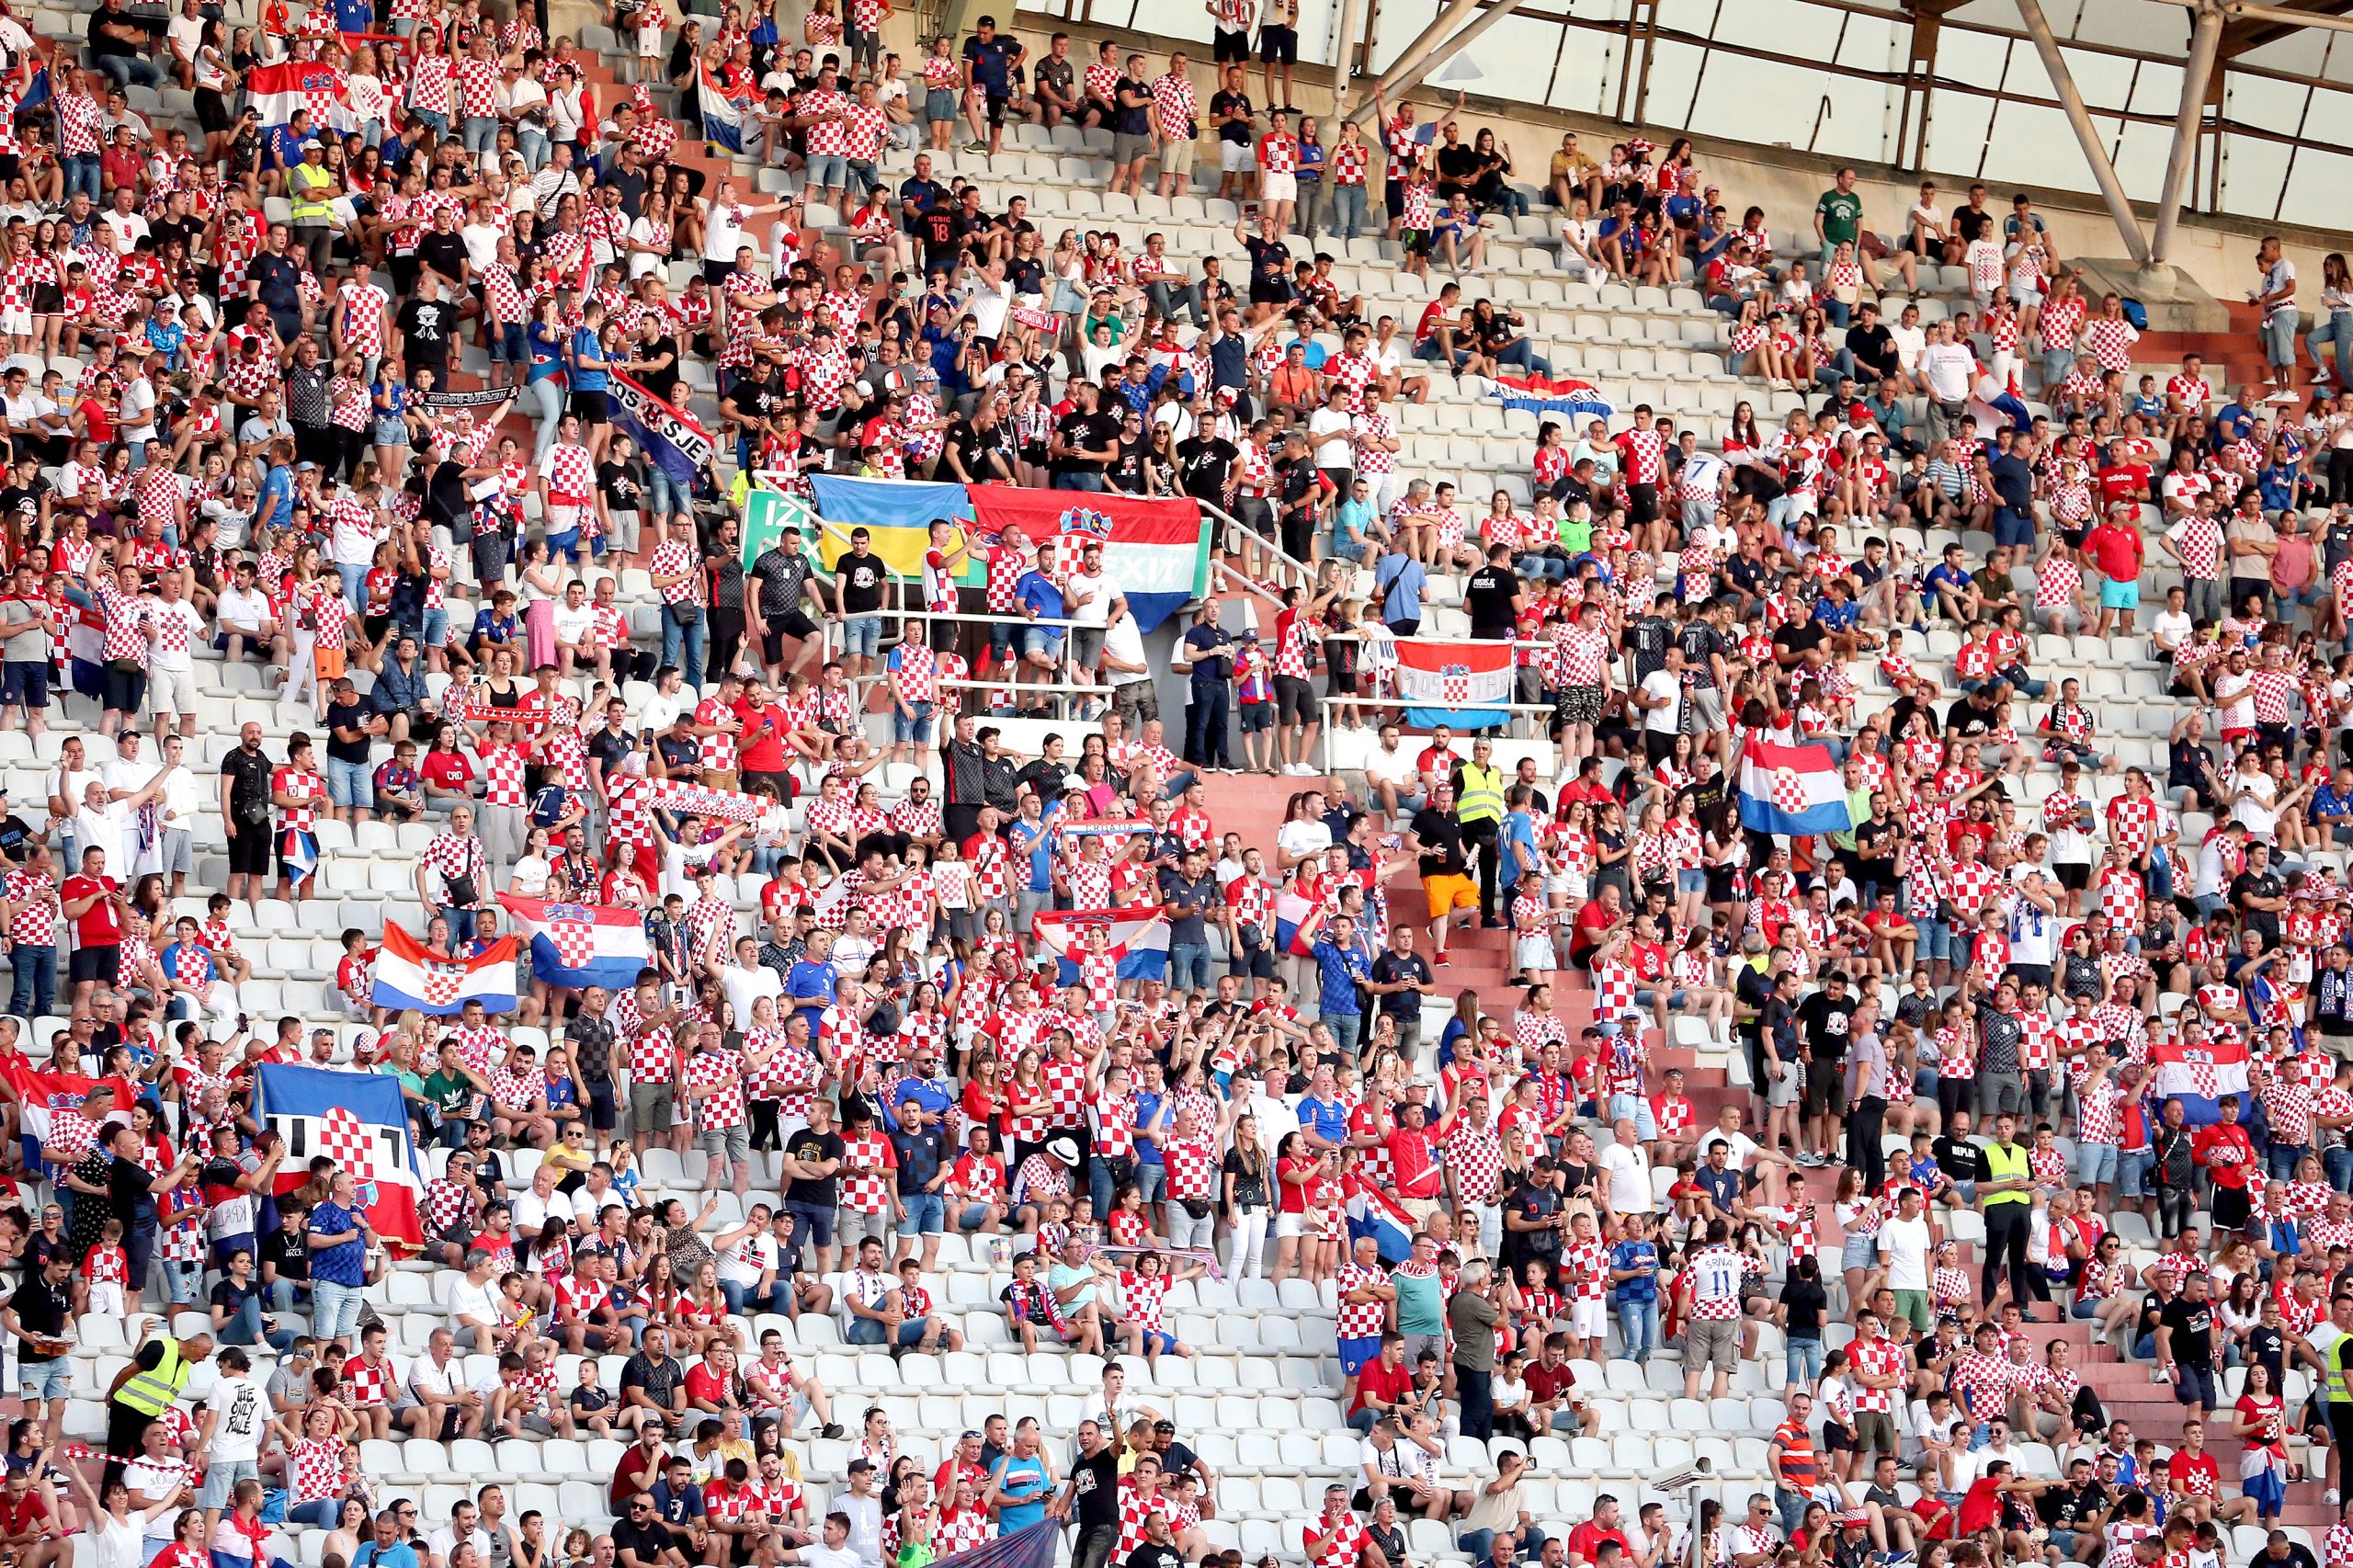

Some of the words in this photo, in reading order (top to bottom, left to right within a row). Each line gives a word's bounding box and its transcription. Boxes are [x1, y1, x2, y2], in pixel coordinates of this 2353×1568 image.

[347, 6, 357, 14] 14
[932, 224, 949, 242] 18
[271, 268, 278, 277] 4
[1690, 460, 1709, 482] 7
[2106, 472, 2133, 483] adidas
[1630, 599, 1641, 609] 10
[668, 755, 678, 765] 17
[447, 771, 463, 780] CRO
[287, 786, 297, 797] 10
[538, 791, 548, 809] 7
[676, 788, 755, 809] HRVATSKA
[1086, 823, 1134, 833] CROATIA
[1108, 846, 1115, 857] 9
[617, 890, 628, 899] 10
[2114, 885, 2123, 895] 10
[1244, 899, 1250, 909] 4
[1391, 971, 1395, 980] 4
[822, 979, 830, 991] 3
[551, 1101, 558, 1110] 7
[1522, 1122, 1529, 1132] 10
[904, 1149, 911, 1161] 7
[1951, 1145, 1976, 1158] REPLAY
[1528, 1203, 1539, 1214] 10
[39, 1254, 48, 1265] 10
[1705, 1259, 1733, 1269] SRNA
[1713, 1270, 1731, 1296] 11
[1145, 1298, 1153, 1311] 7
[234, 1383, 255, 1403] THE
[231, 1403, 257, 1420] ONLY
[226, 1417, 251, 1435] RULE
[150, 1473, 181, 1485] s.Olive
